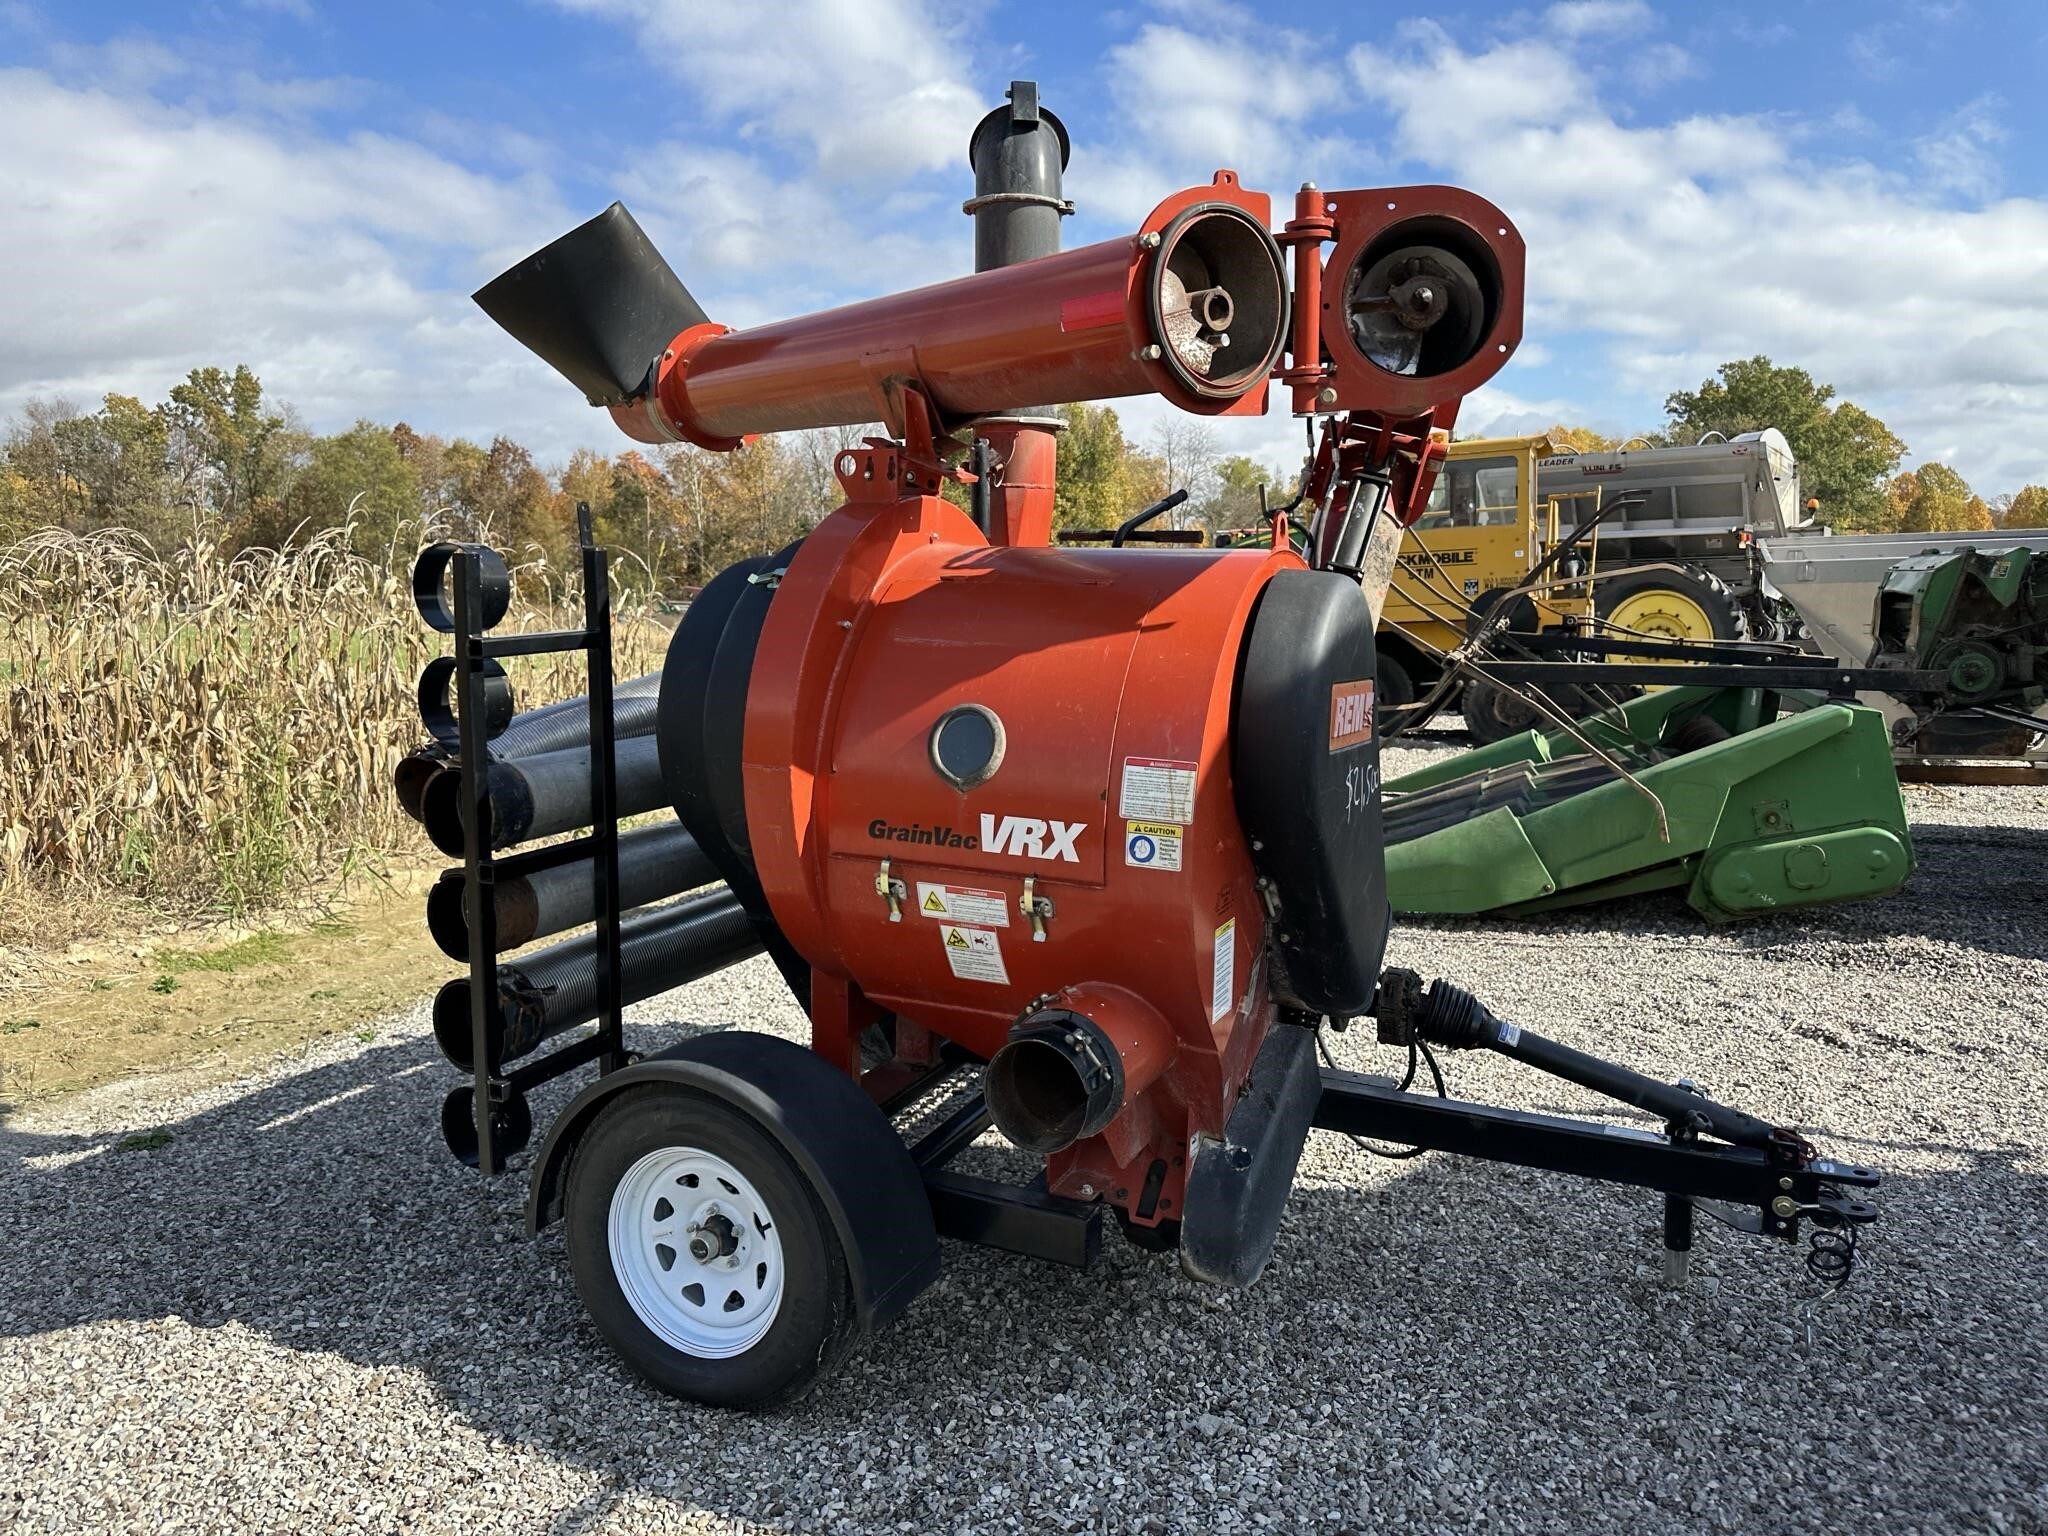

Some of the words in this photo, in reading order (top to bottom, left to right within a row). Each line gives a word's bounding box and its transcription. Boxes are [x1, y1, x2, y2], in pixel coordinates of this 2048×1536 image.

[1538, 458, 1574, 467] LEADER
[1395, 551, 1474, 566] CKMOBILE
[1143, 826, 1176, 836] CAUTION
[868, 819, 978, 850] GrainVac
[980, 813, 1088, 863] VRX
